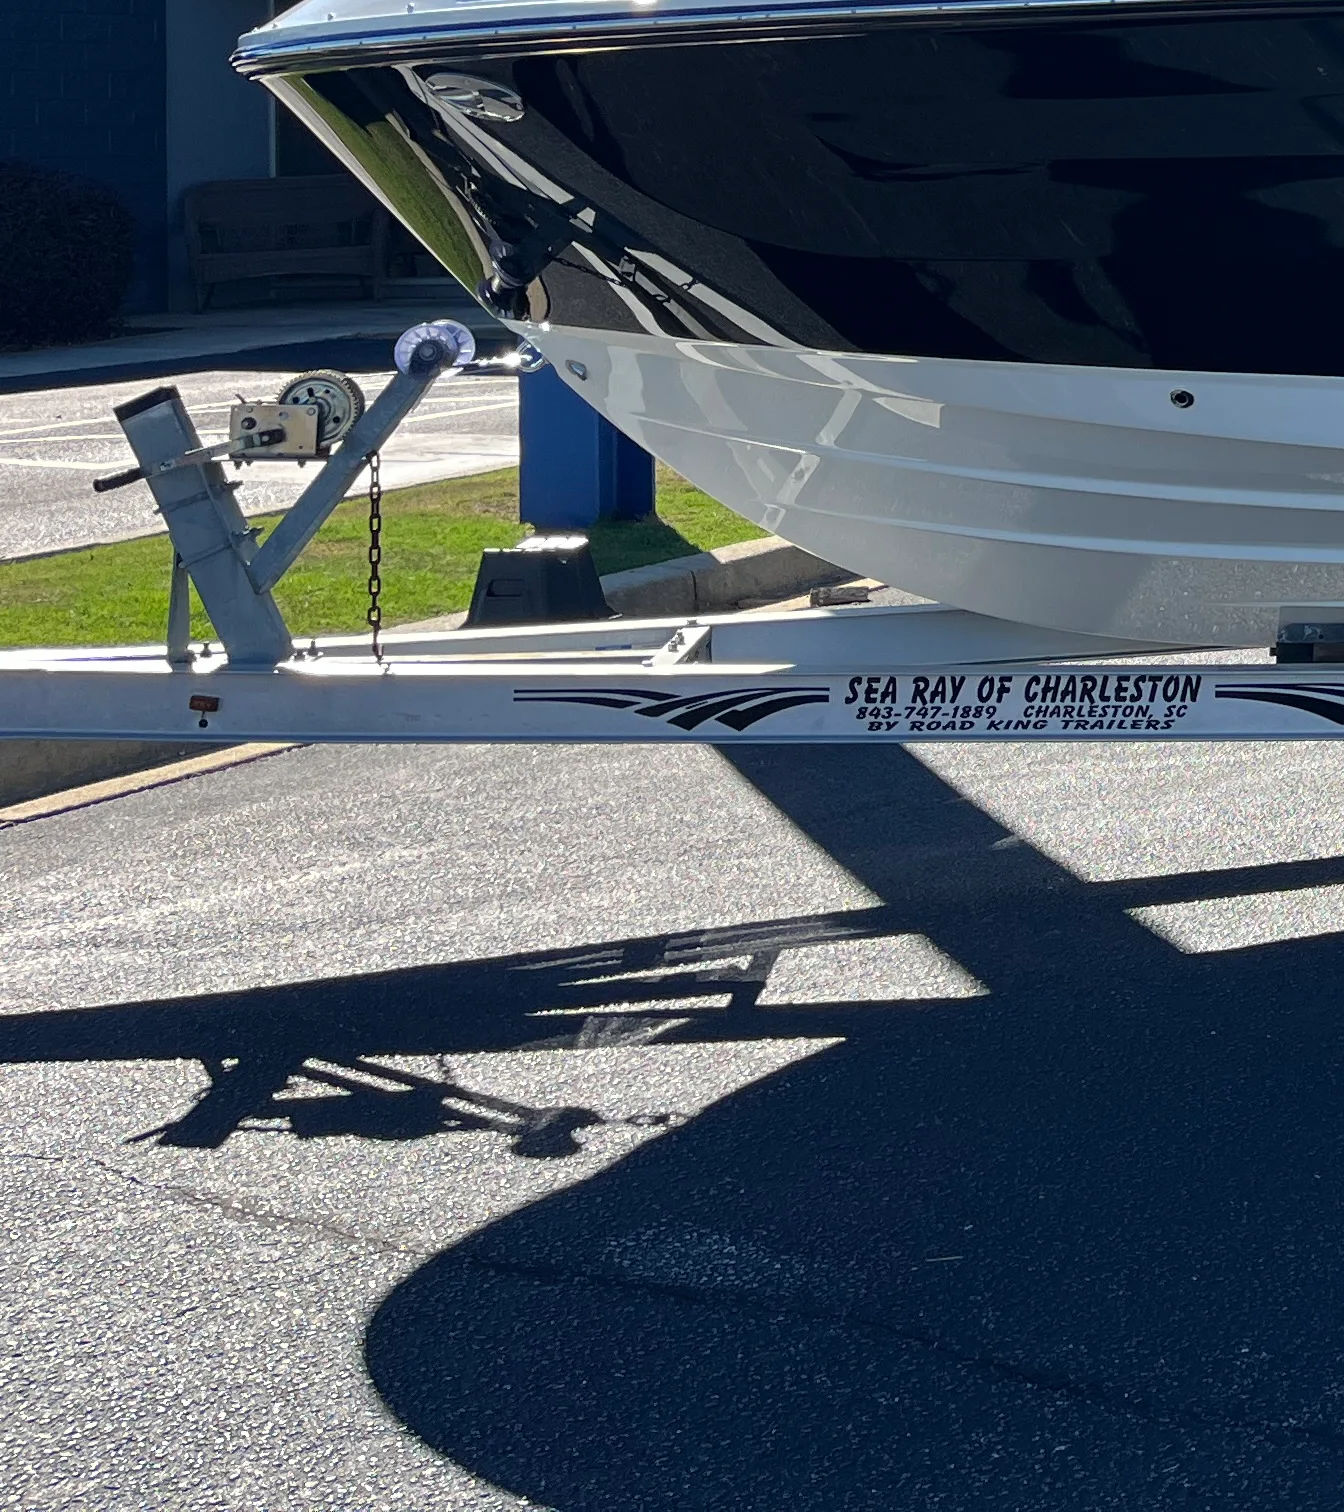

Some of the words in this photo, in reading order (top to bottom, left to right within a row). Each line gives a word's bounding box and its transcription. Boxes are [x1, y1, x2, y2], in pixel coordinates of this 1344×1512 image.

[844, 675, 898, 705] SEA
[911, 675, 966, 705] RAY
[977, 675, 1014, 704] OF
[1024, 674, 1202, 704] CHARLESTON
[855, 705, 998, 720] 843-747-1889
[1023, 705, 1155, 720] CHARLESTON,
[1164, 705, 1188, 718] SC
[867, 720, 899, 732] BY
[909, 719, 976, 732] ROAD
[987, 719, 1049, 732] KING
[1062, 719, 1176, 732] TRAILERS
